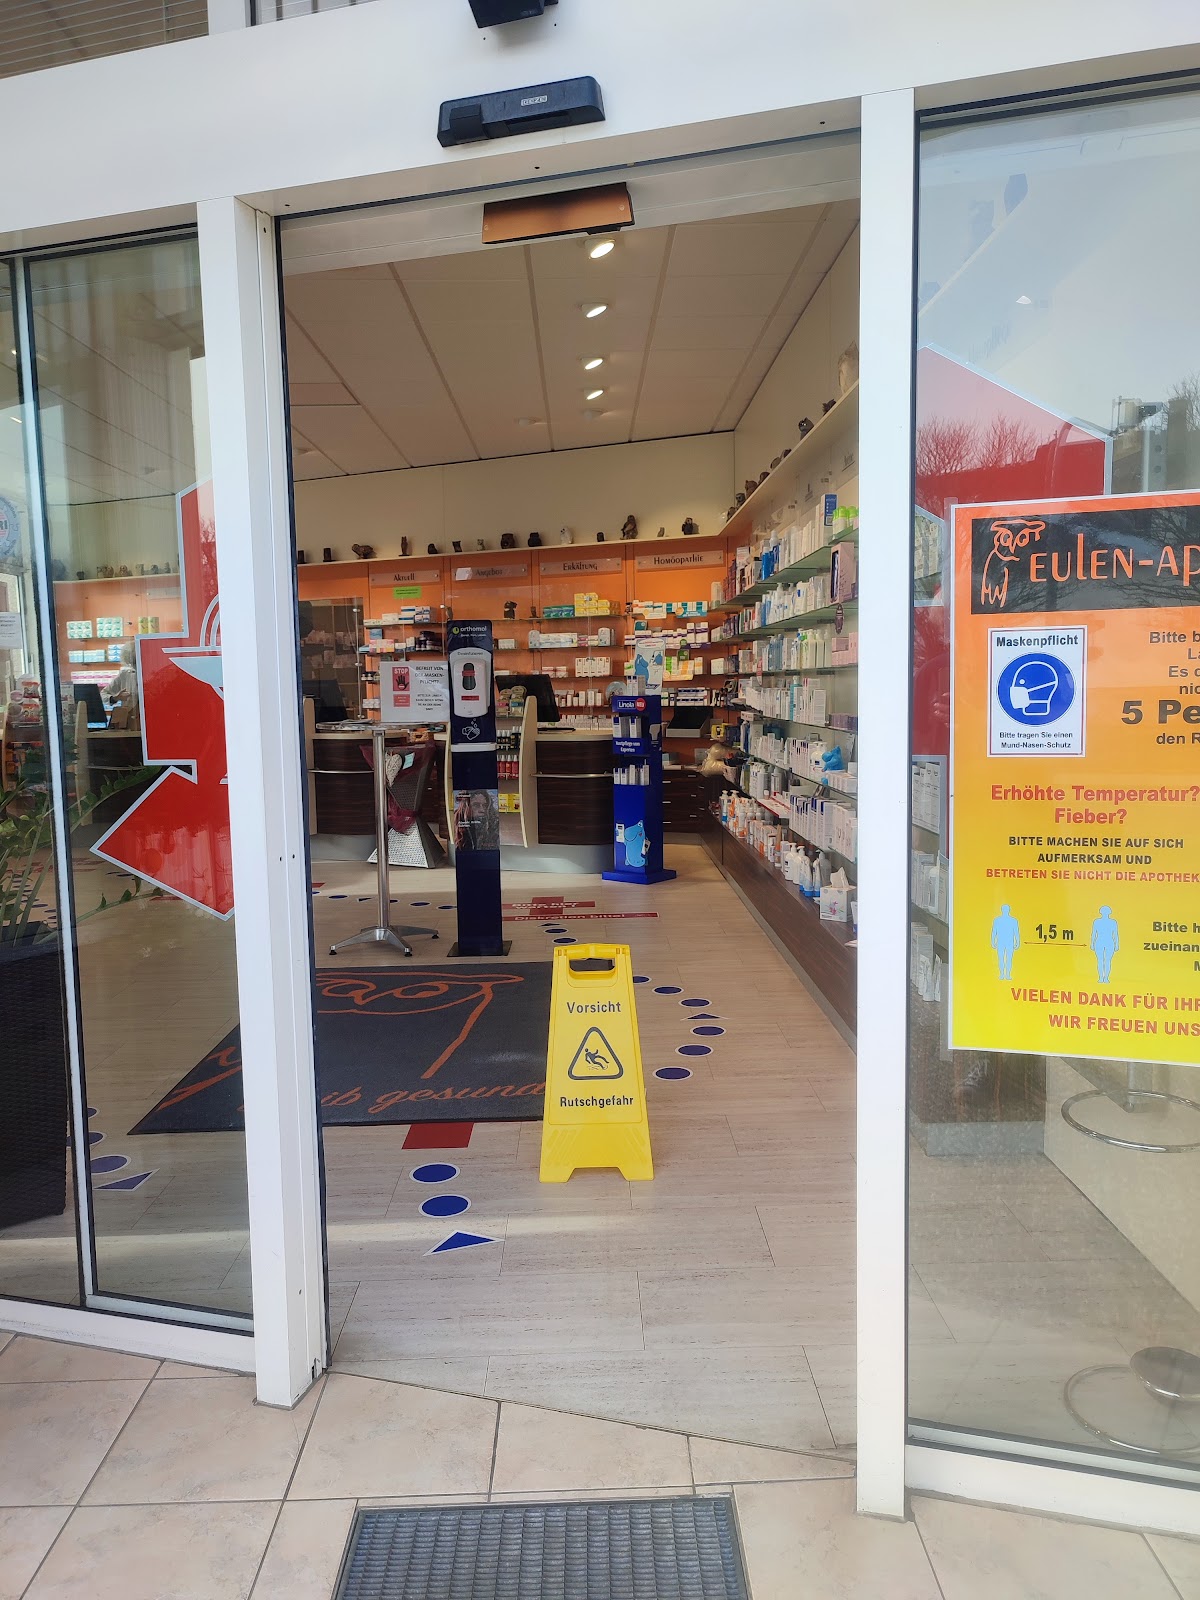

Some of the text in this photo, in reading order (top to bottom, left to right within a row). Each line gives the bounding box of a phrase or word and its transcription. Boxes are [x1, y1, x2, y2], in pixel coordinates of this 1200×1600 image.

[996, 635, 1079, 648] Maskenpflicht
[1149, 631, 1187, 644] Bitte
[394, 667, 409, 675] STOP
[1168, 666, 1189, 678] Es
[1121, 699, 1200, 725] 5 Pe
[1017, 732, 1040, 740] tragen
[1156, 732, 1186, 745] den
[991, 784, 1200, 805] Erhöhte Temperatur?
[1055, 807, 1127, 824] Fieber?
[1009, 836, 1184, 848] BITTE MACHEN SIE AUF SICH
[1037, 853, 1152, 865] AUFMERKSAM UND
[986, 868, 1200, 883] BETRETEN SIE NICHT DIE APOTHEK
[1035, 923, 1074, 942] 1,5 m
[1152, 921, 1188, 933] Bitte
[1143, 941, 1200, 952] zueinan
[1011, 987, 1072, 1004] VIELEN
[1078, 991, 1127, 1008] DANK
[1132, 993, 1168, 1010] FÜR
[566, 1001, 622, 1013] Vorsicht
[1048, 1014, 1200, 1037] WIR FREUEN UNS
[560, 1095, 634, 1109] Rutschgefahr
